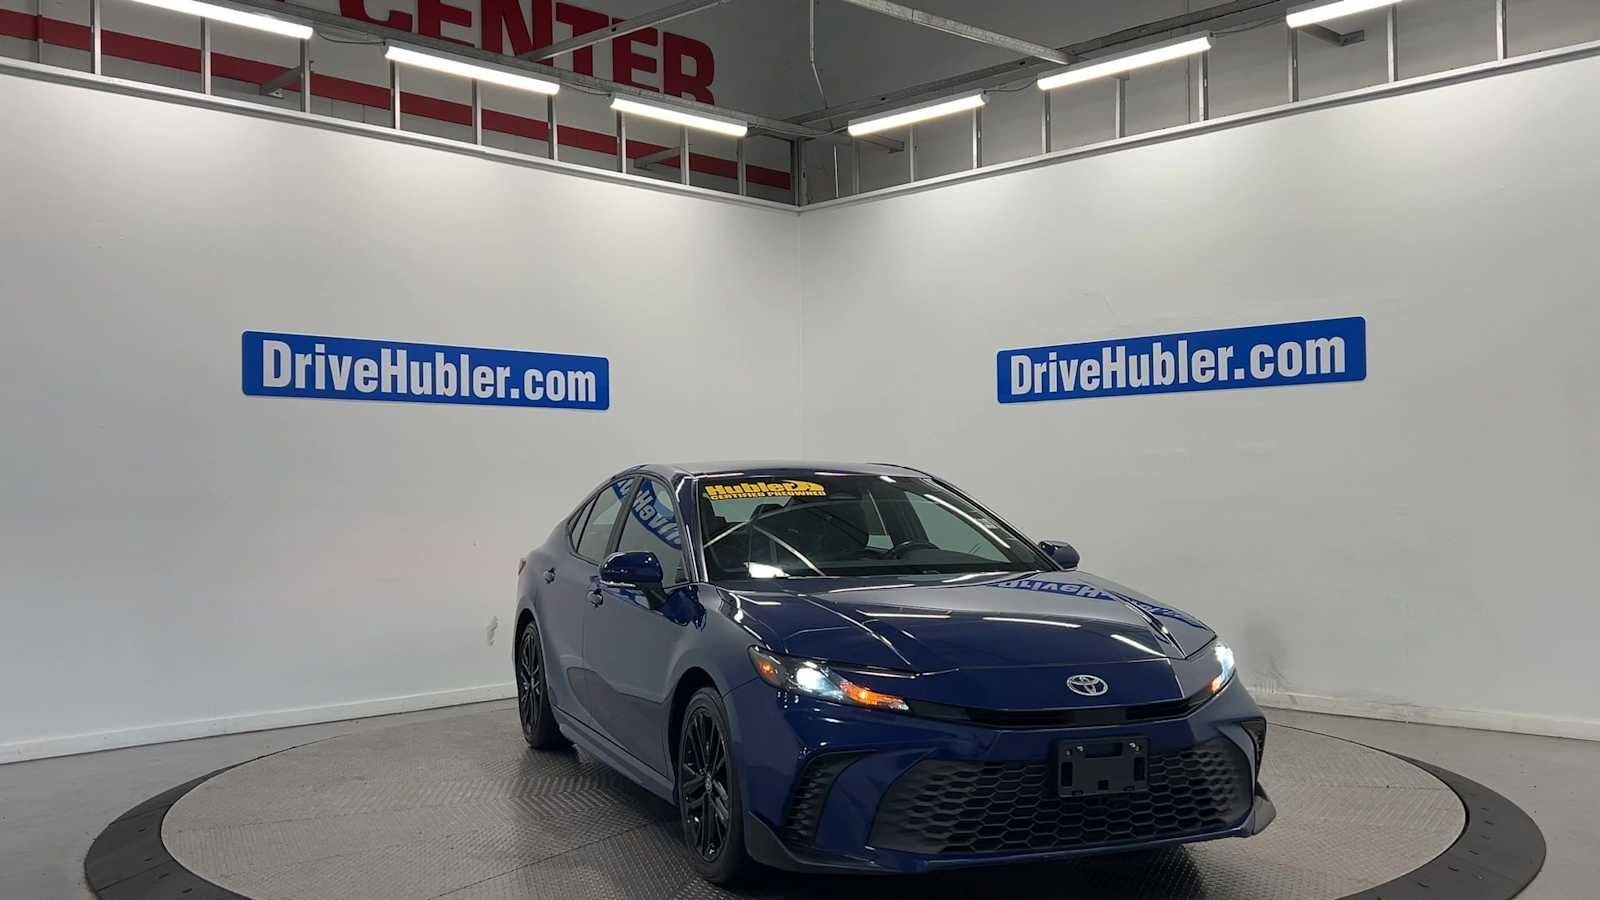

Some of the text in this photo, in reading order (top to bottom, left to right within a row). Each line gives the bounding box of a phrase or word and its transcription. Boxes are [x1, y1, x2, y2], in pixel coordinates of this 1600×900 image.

[261, 339, 597, 402] DriveHubler.com
[1010, 334, 1346, 396] DriveHubler.com
[704, 481, 800, 496] Hubler
[710, 490, 766, 500] CERTIFIED
